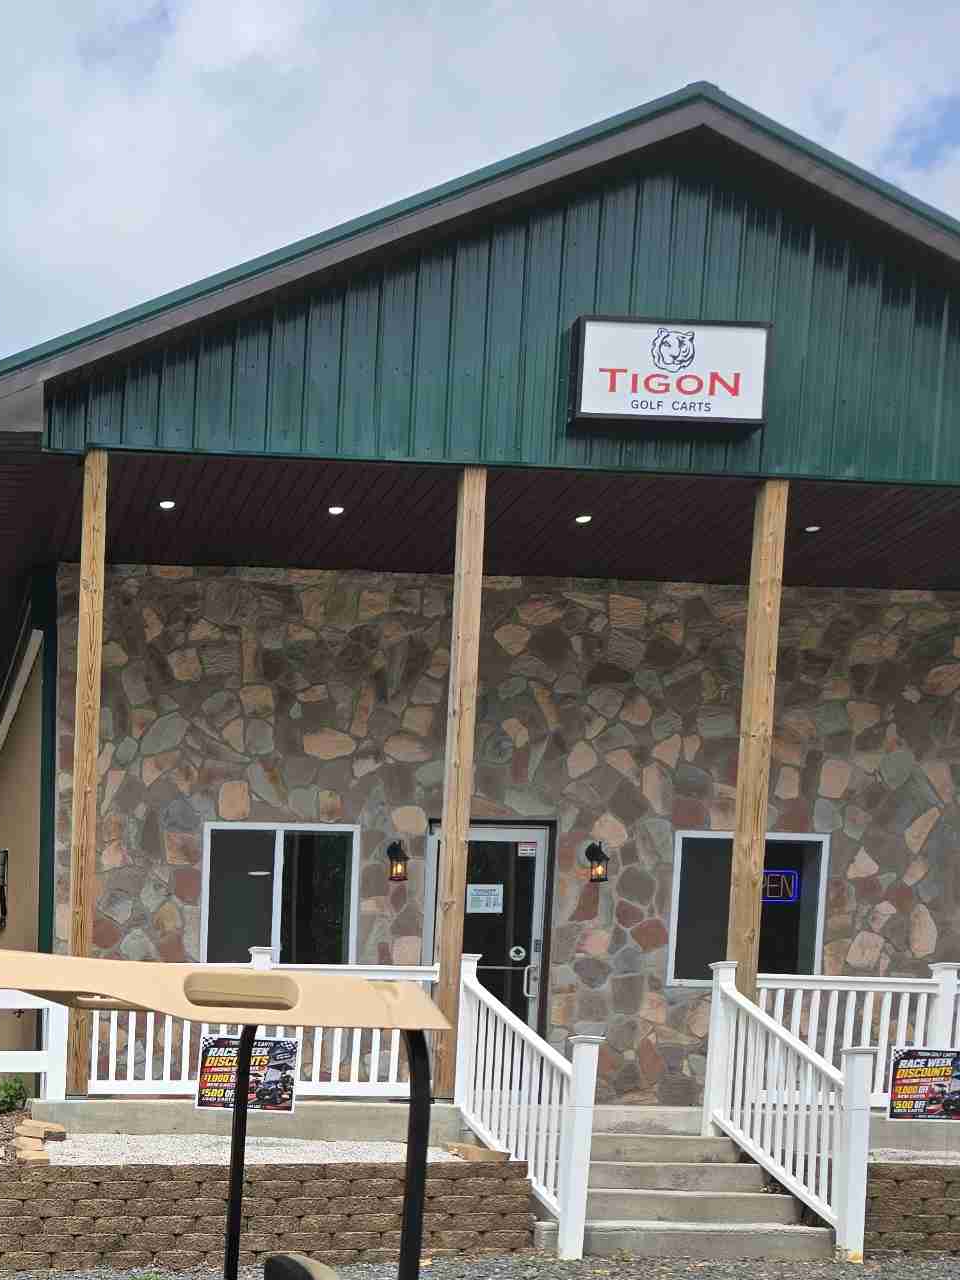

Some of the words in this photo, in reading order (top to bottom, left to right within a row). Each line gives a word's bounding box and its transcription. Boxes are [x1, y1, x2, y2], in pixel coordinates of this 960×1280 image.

[599, 368, 741, 397] TIGON
[631, 400, 664, 410] GOLF
[672, 401, 712, 412] CARTS
[762, 873, 794, 898] EN
[208, 1047, 240, 1057] RACE
[205, 1056, 270, 1067] DISCNTS
[898, 1059, 927, 1068] RACE
[927, 1058, 953, 1067] WEEK
[895, 1067, 953, 1079] DISCOUNTS
